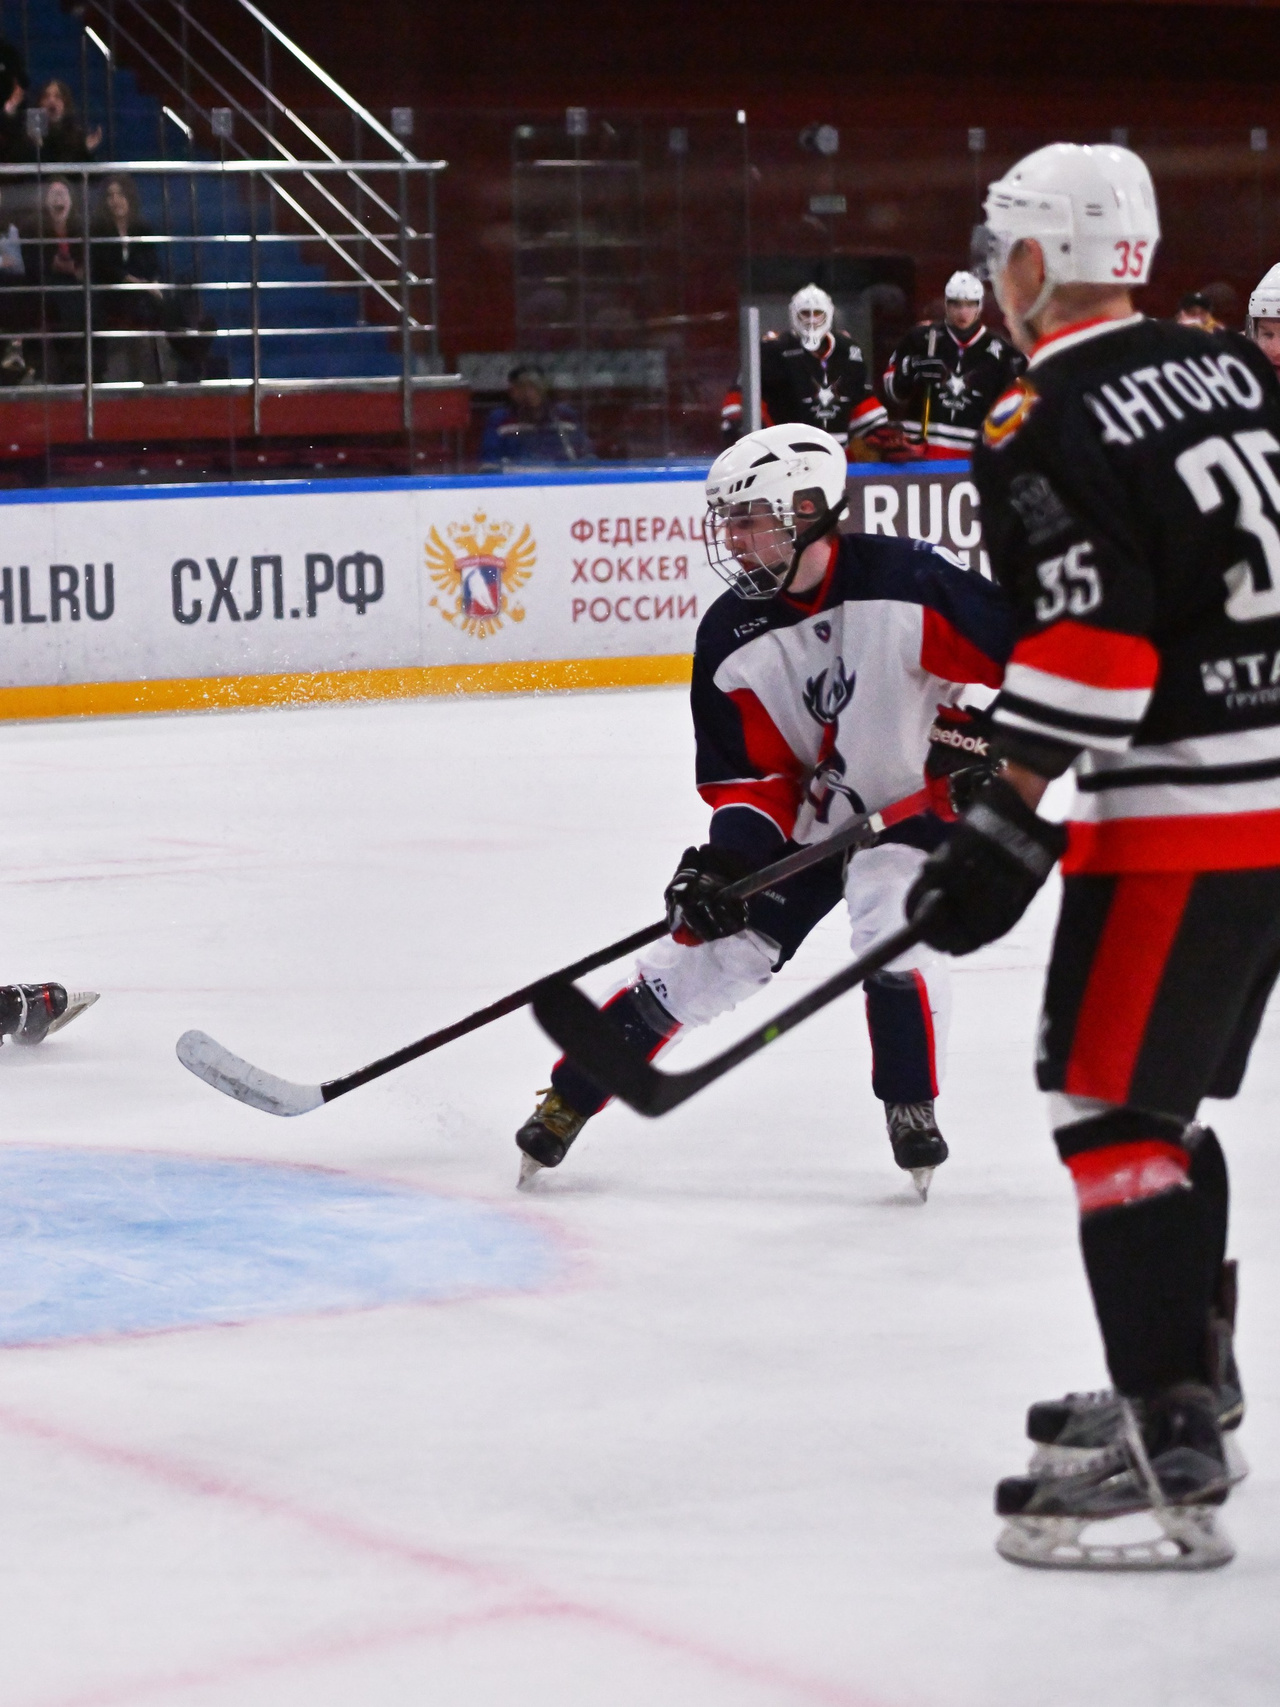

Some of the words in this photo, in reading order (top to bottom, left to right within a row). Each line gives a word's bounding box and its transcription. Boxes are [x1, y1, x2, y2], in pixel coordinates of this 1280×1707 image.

[1111, 240, 1148, 277] 35
[170, 550, 386, 625] СХЛ.РФ
[570, 555, 689, 584] ХОККЕЯ
[1034, 540, 1104, 623] 35
[571, 595, 699, 624] РОССИИ
